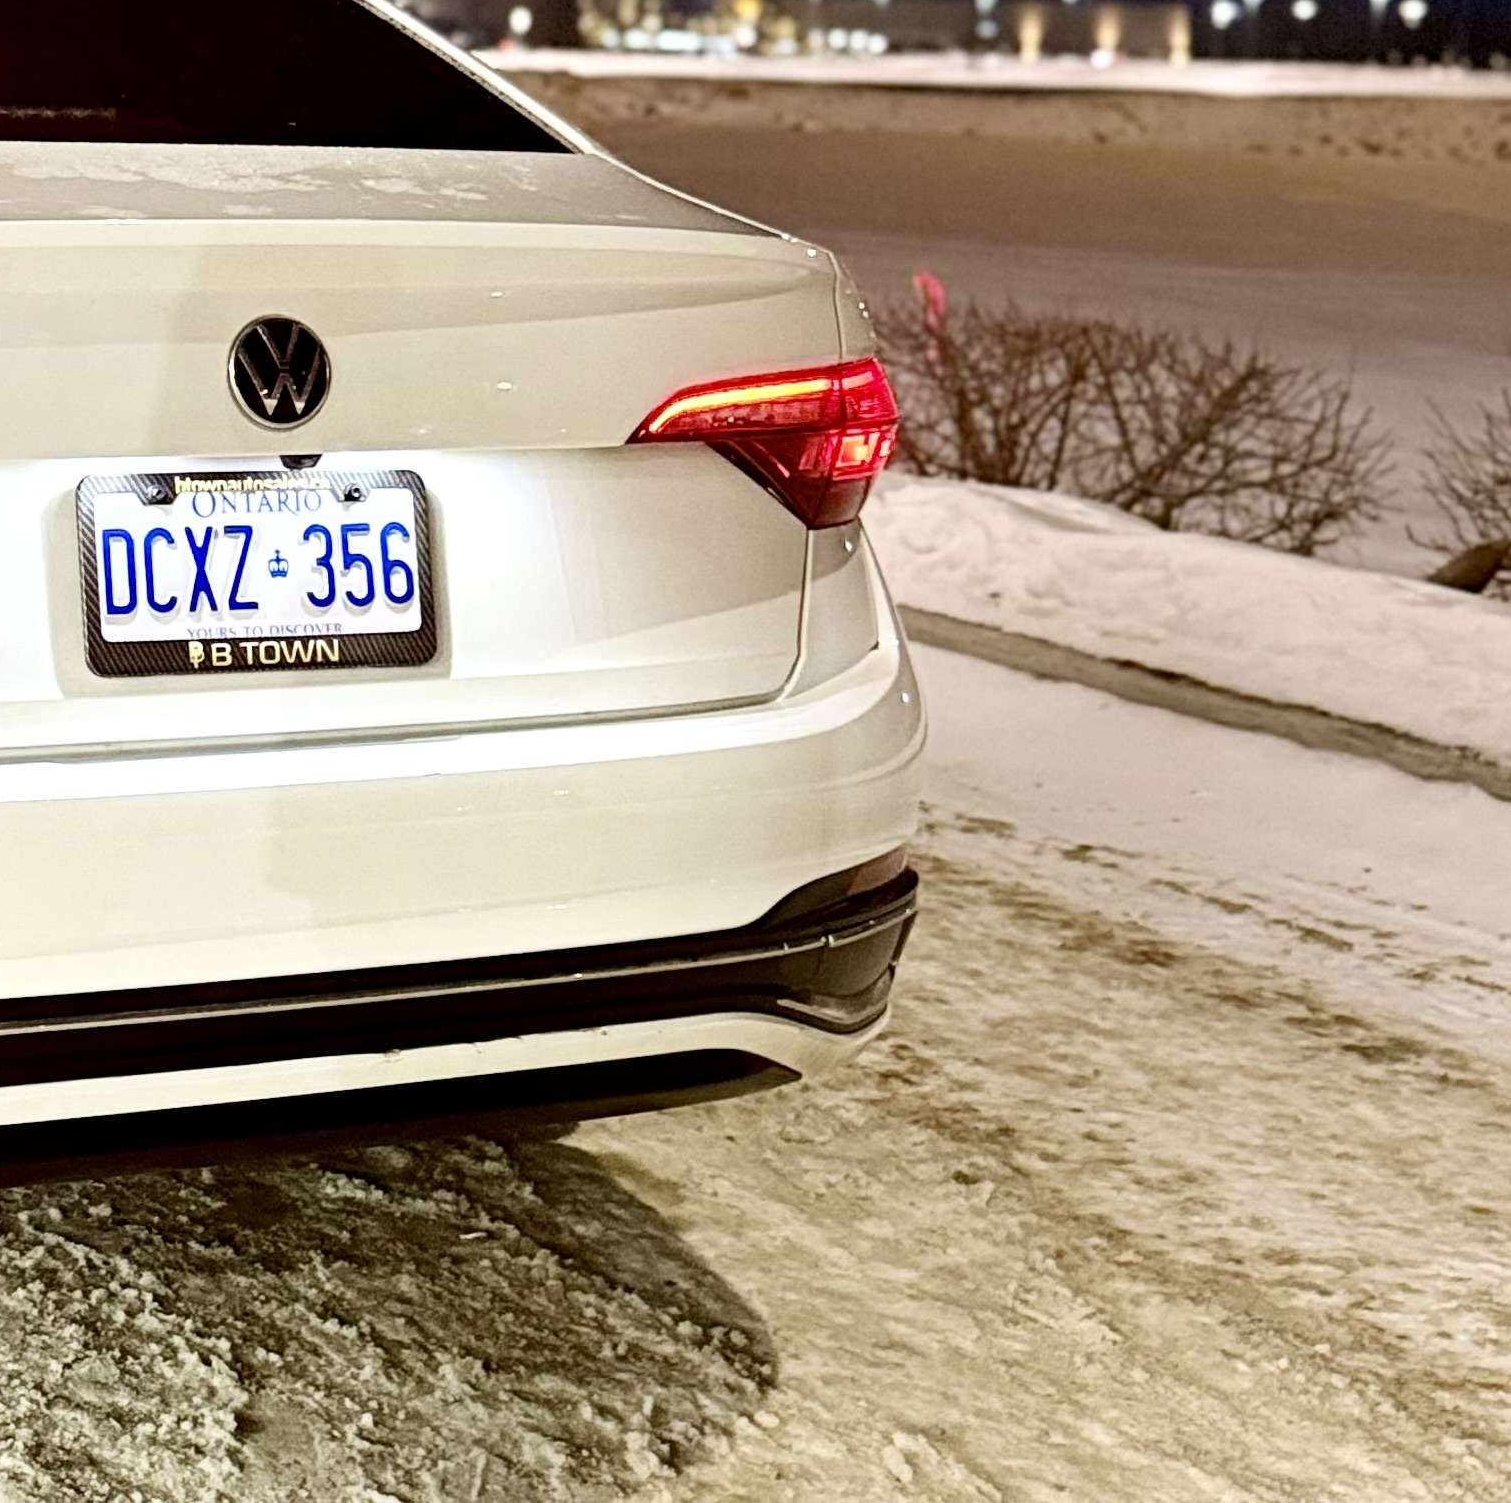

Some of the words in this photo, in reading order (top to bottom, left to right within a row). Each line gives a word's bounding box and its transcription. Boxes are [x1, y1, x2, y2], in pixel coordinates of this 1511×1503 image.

[192, 489, 322, 518] ONTARIO
[101, 525, 258, 615] DCXZ
[303, 522, 415, 608] 356
[211, 642, 233, 667] B
[239, 638, 339, 666] TOWN
